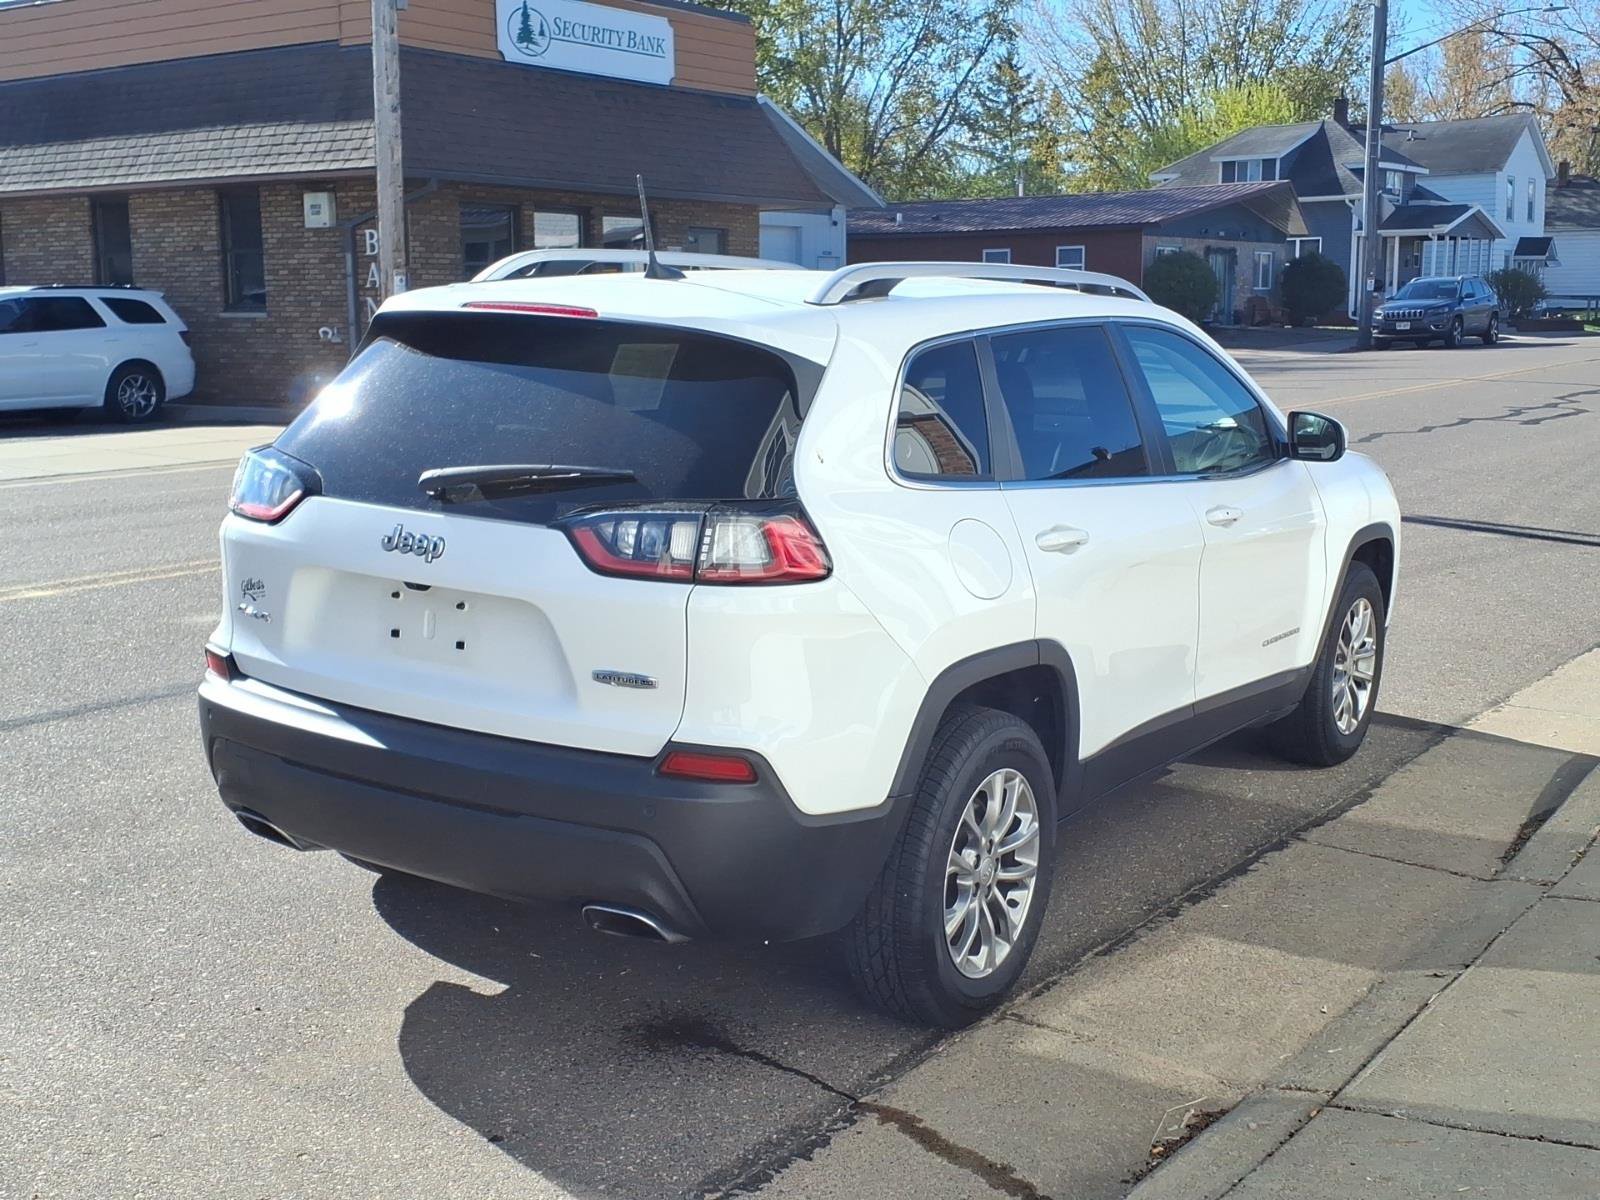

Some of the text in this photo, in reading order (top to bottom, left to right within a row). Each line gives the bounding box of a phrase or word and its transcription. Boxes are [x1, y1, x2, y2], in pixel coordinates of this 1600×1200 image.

[553, 17, 665, 54] SECURITY BANK
[382, 523, 445, 563] Jeep
